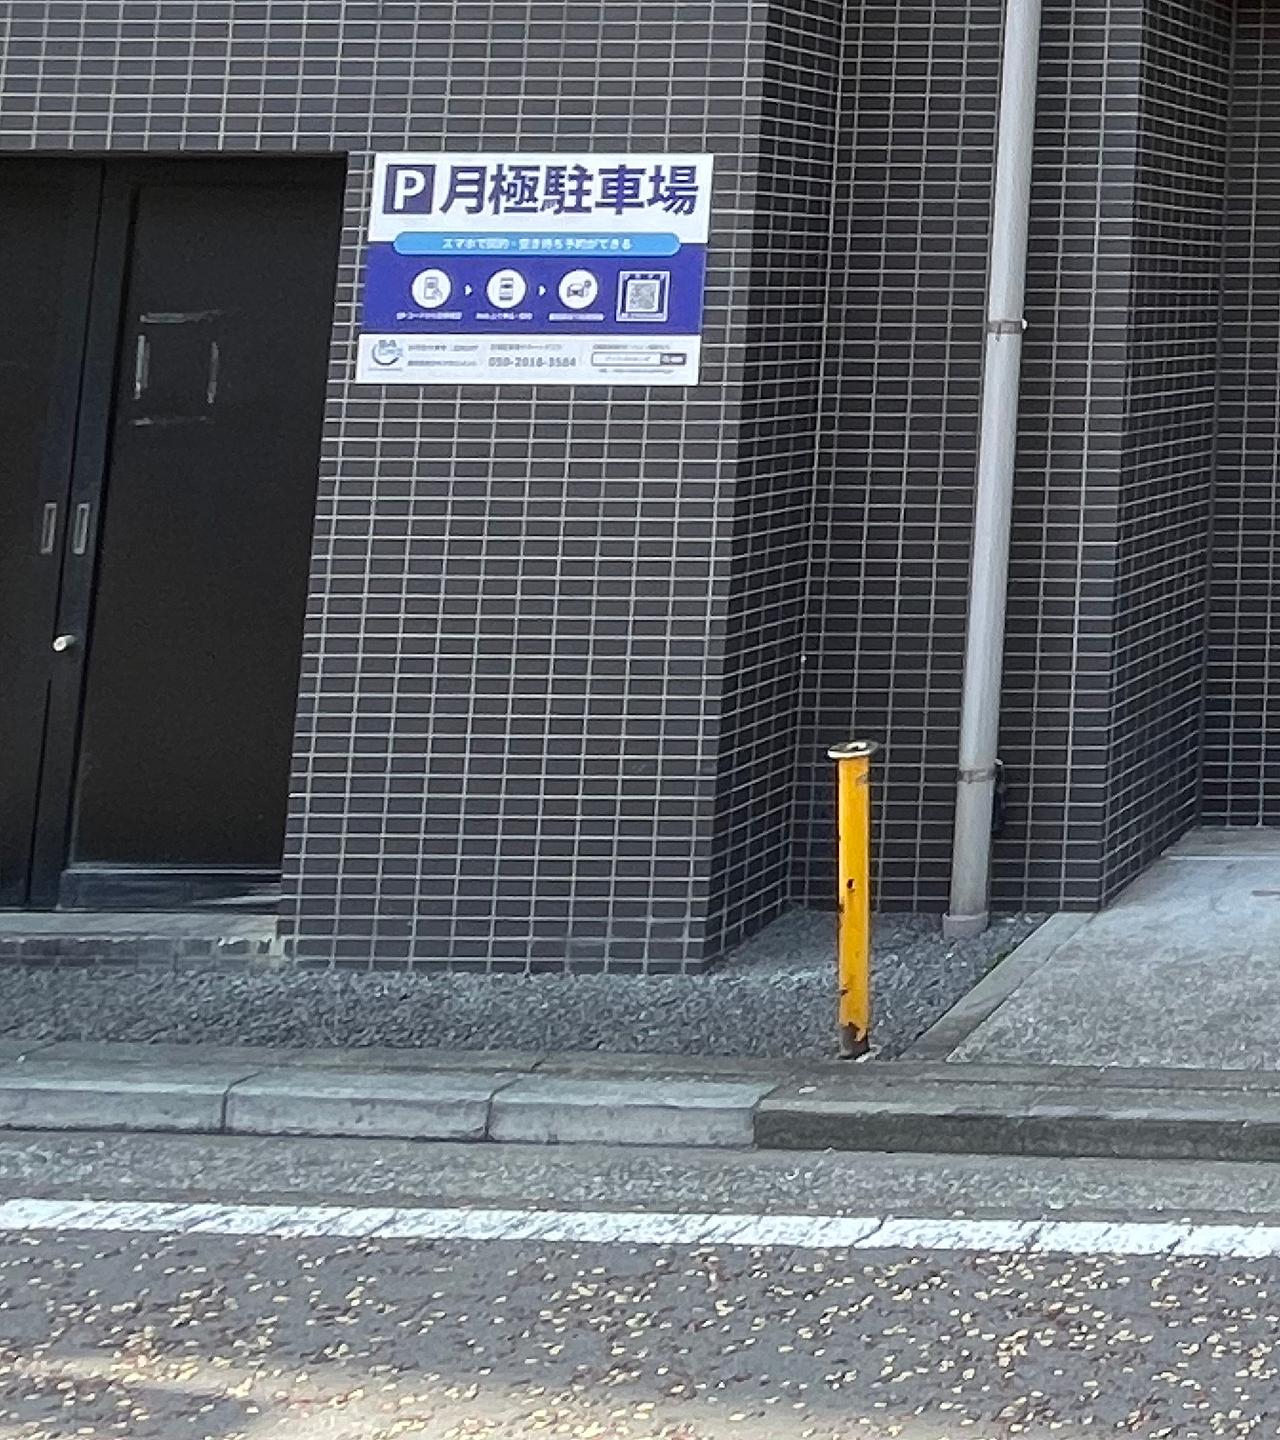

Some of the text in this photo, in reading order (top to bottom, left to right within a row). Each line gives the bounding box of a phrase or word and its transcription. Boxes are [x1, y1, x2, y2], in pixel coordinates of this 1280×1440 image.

[439, 164, 699, 215] 月極駐車場
